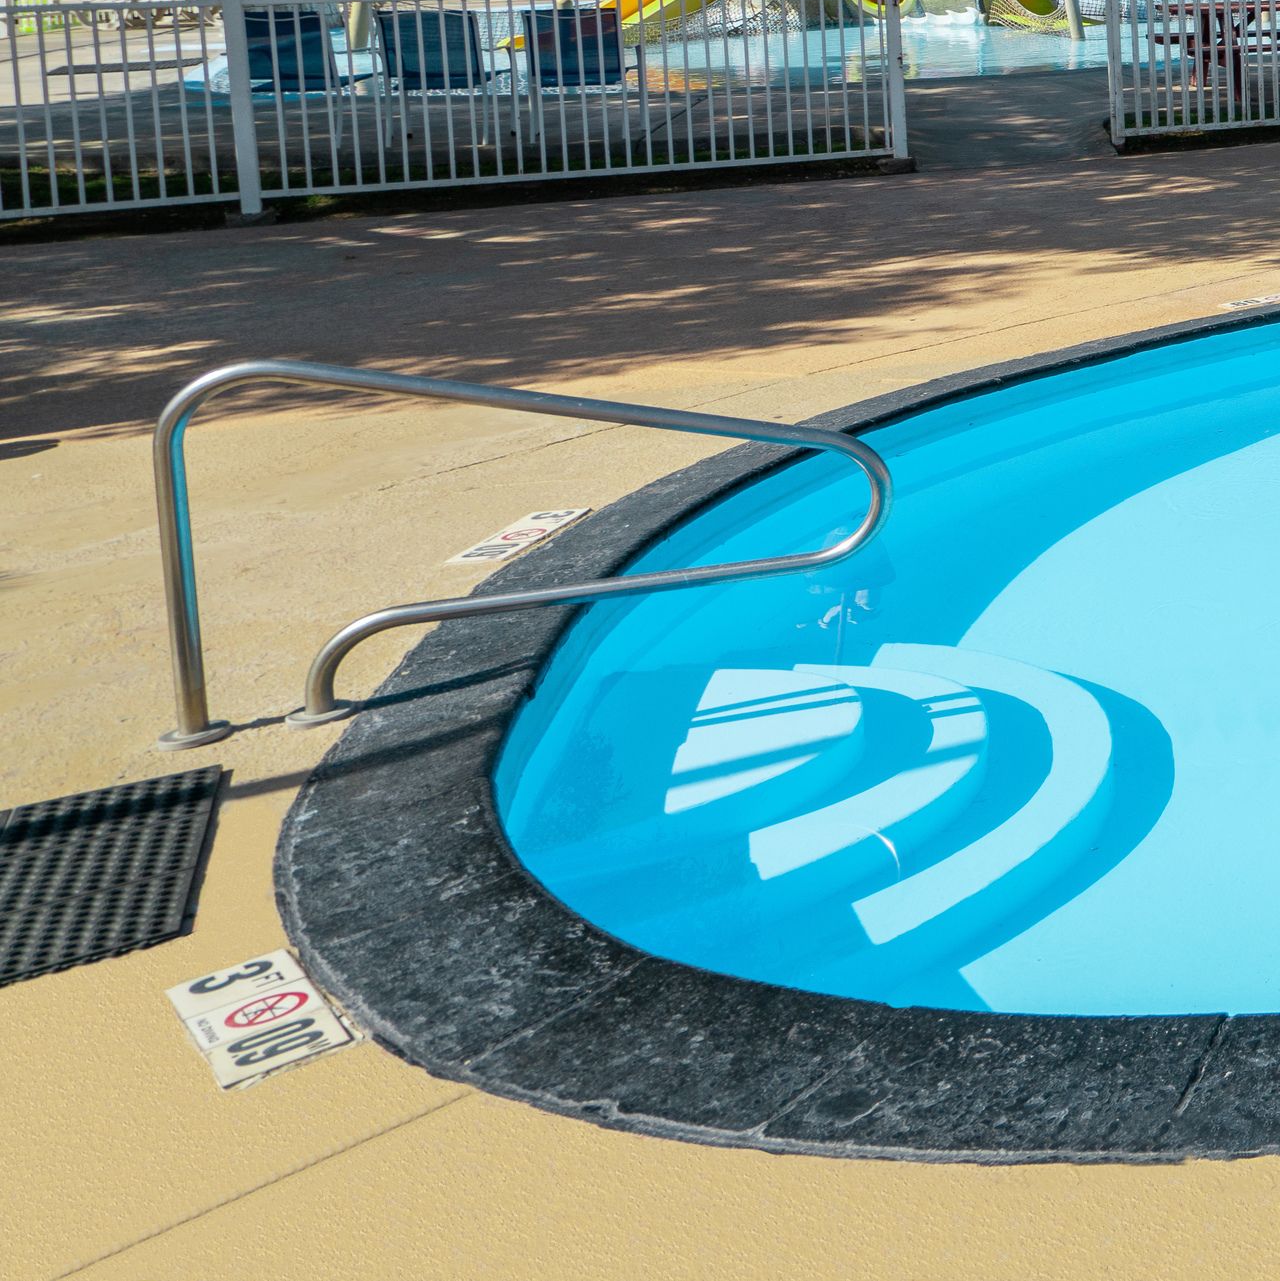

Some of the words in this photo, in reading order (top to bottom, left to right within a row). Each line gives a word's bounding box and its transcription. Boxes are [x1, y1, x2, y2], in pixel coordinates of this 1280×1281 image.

[189, 960, 274, 995] 3
[251, 971, 285, 989] FT
[196, 1018, 209, 1030] NO
[201, 1026, 221, 1045] DIVING
